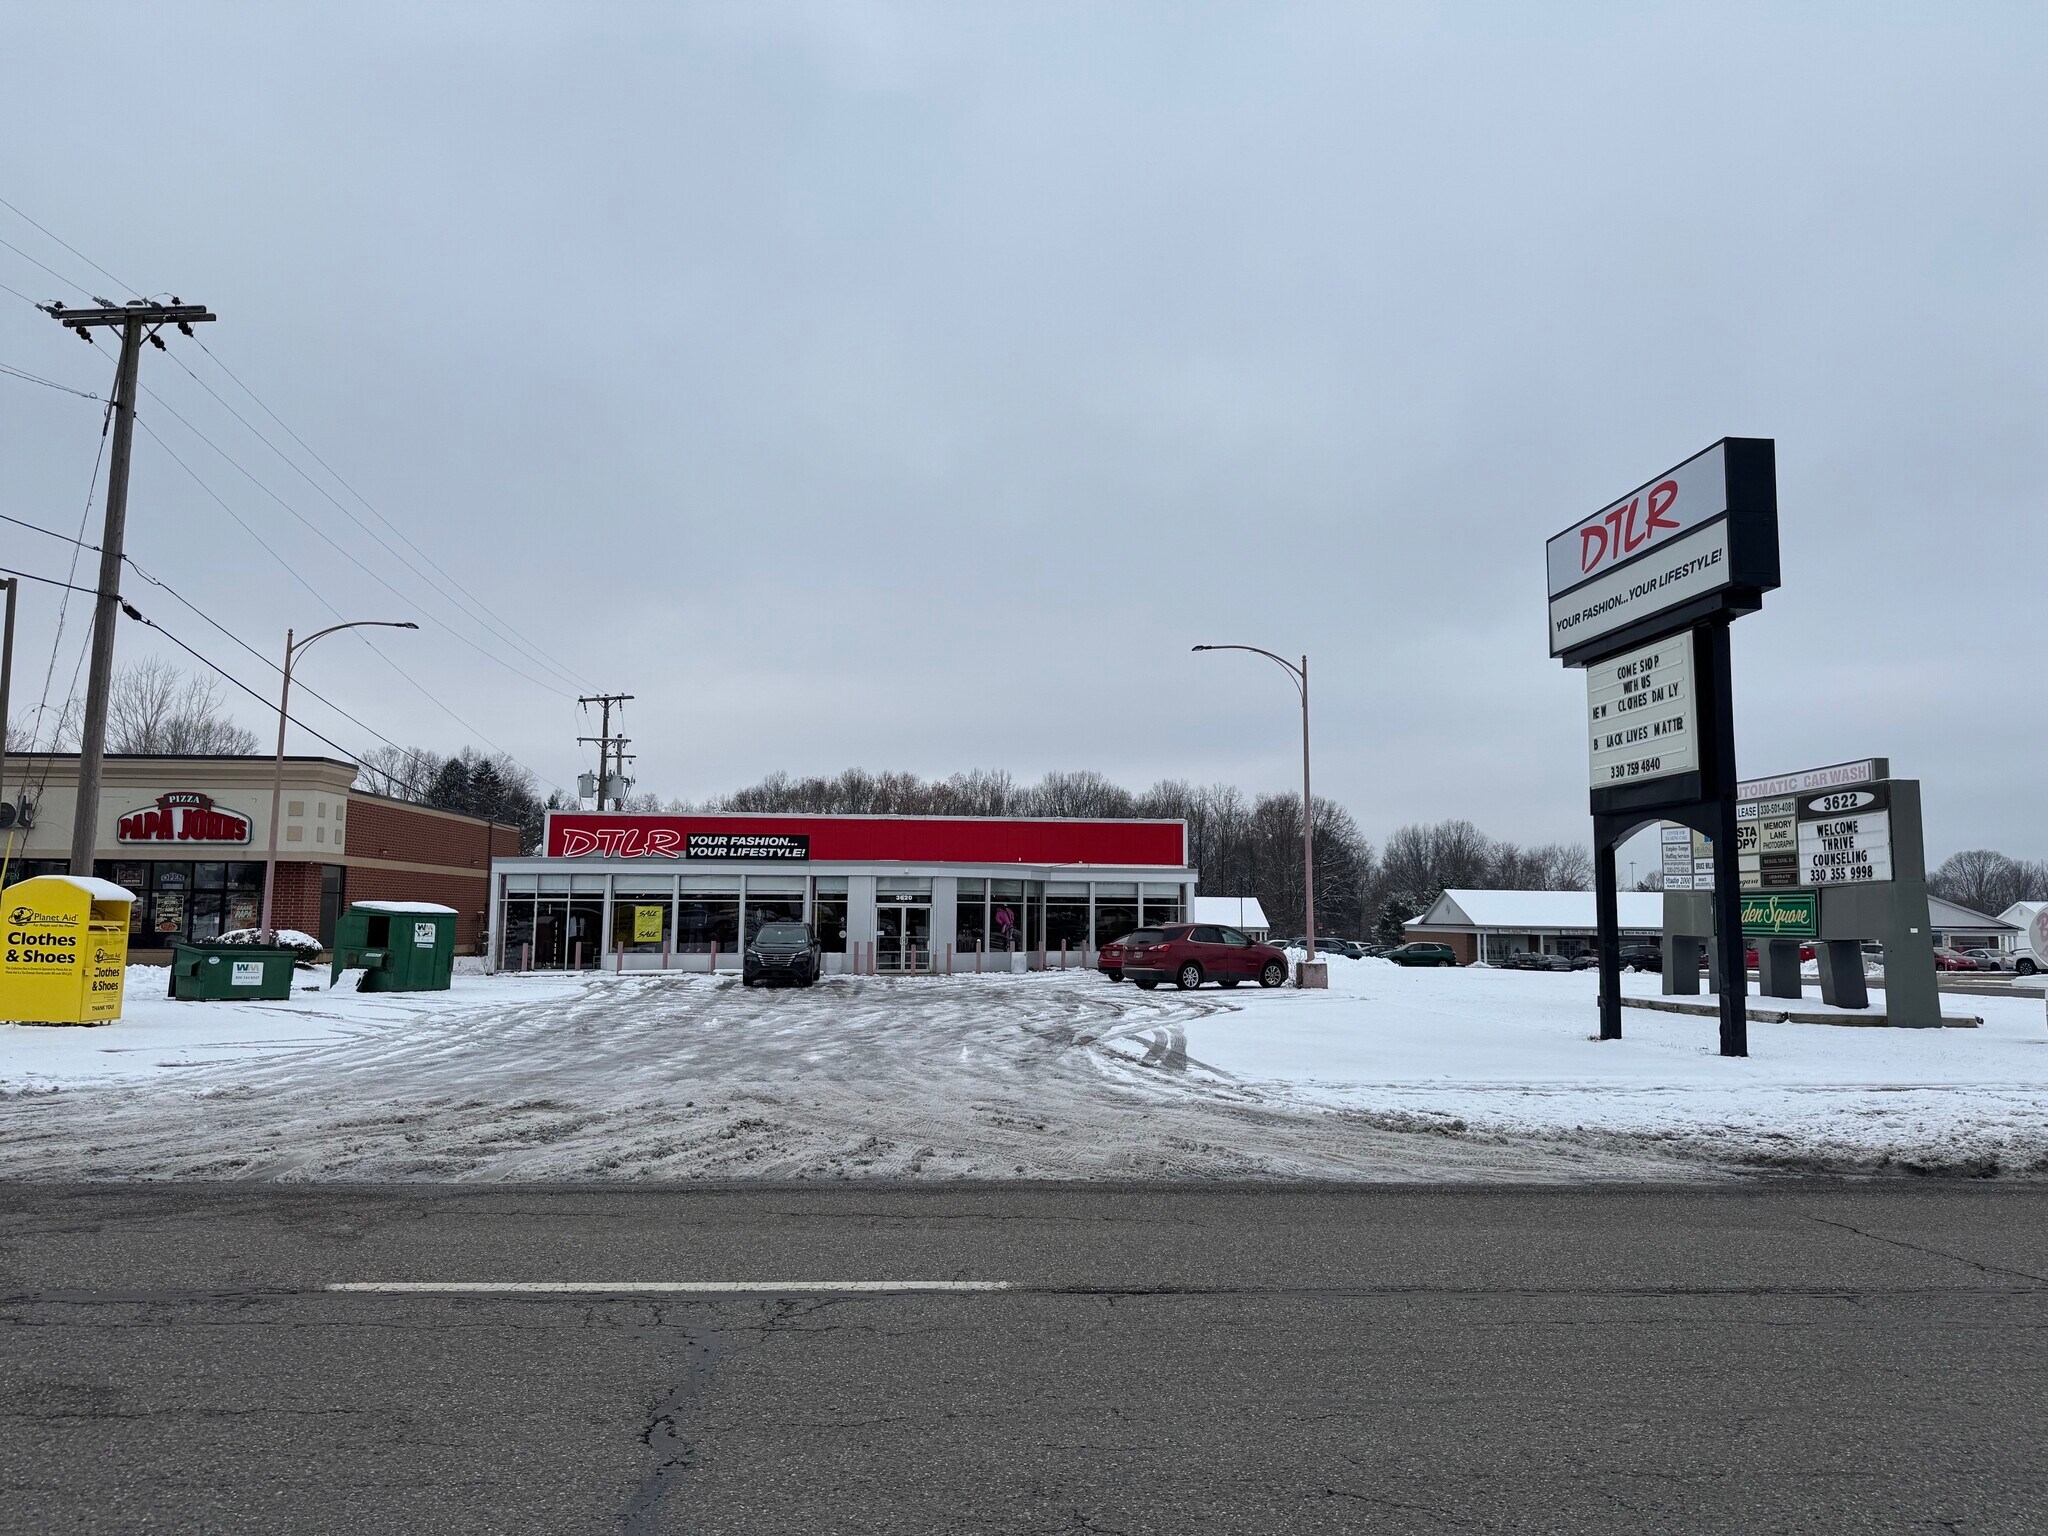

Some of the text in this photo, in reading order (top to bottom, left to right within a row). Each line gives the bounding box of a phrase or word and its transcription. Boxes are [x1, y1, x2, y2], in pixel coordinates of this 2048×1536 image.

[1580, 479, 1680, 574] DTLR
[1556, 612, 1581, 632] YOUR
[1659, 547, 1723, 588] LIFESTYLE!
[1617, 655, 1660, 680] COME SHOP
[1623, 674, 1651, 695] WITH US
[1592, 705, 1607, 720] NEW
[1626, 726, 1648, 744] LIVES
[1610, 757, 1661, 779] 330 759 4840
[1803, 772, 1828, 788] CAR
[1829, 766, 1867, 784] WASH
[168, 794, 201, 805] PIZZA
[1823, 793, 1858, 811] 3622
[1737, 806, 1757, 818] LEASE
[119, 809, 248, 840] PAPA JOHN'S
[1737, 826, 1757, 838] STA
[1763, 819, 1792, 831] MEMORY
[1816, 820, 1859, 837] WELCOME
[690, 836, 798, 847] YOUR FASHION...
[1769, 831, 1787, 840] LANE
[563, 828, 680, 859] DTLR
[1737, 838, 1757, 850] OPY
[1762, 839, 1795, 850] PHOTOGRAPHY
[1821, 836, 1854, 851] THRIVE
[689, 847, 806, 858] YOUR LIFESTYLE!
[1812, 850, 1868, 867] COUNSELING
[161, 872, 185, 881] OPEN
[1810, 865, 1873, 882] 330 355 9998
[34, 912, 77, 922] Planet Aid
[1741, 896, 1810, 933] den Square
[7, 931, 76, 946] Clothes
[5, 949, 76, 964] & Shoes
[236, 963, 259, 971] WM
[91, 980, 119, 992] & Shoes
